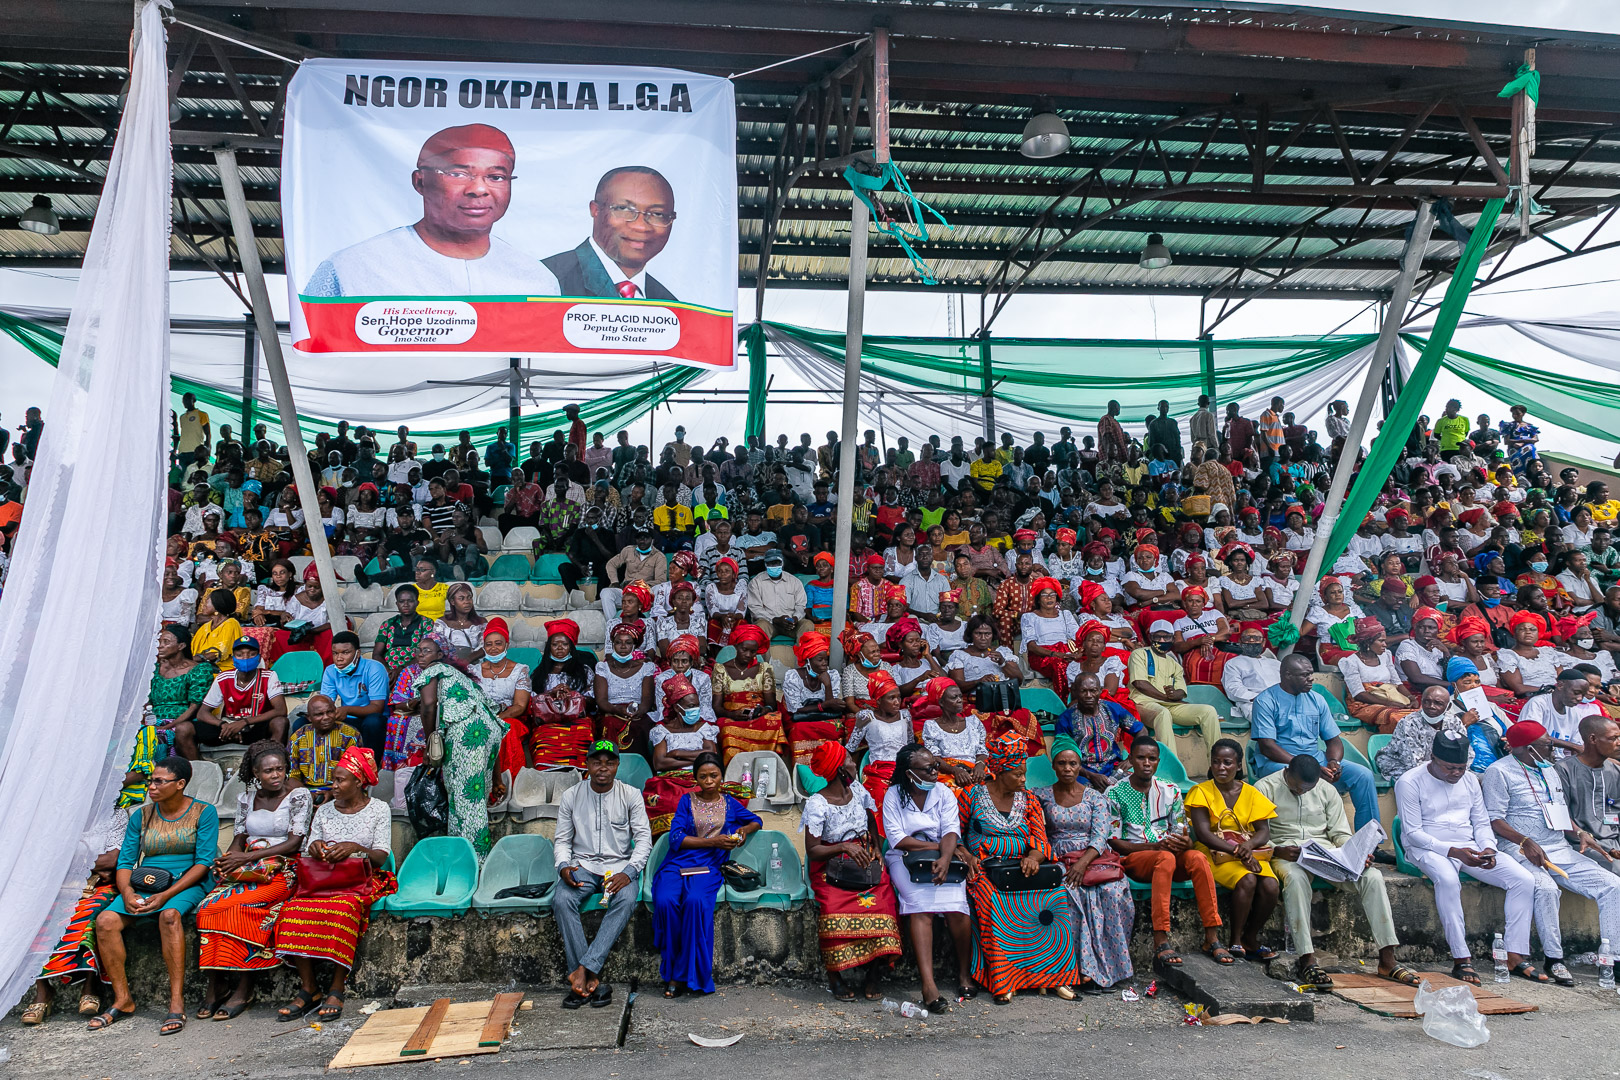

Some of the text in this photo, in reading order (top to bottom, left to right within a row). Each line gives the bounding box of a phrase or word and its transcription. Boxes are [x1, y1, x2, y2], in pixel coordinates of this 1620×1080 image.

[343, 74, 693, 113] NGOR OKPALA L.G.A
[383, 307, 400, 315] His
[426, 317, 476, 326] Uzodinma
[567, 313, 678, 326] PROF. PLACID NJOKU
[378, 325, 454, 337] Governor
[583, 324, 666, 334] Deputy Governor
[601, 334, 648, 343] Imo State
